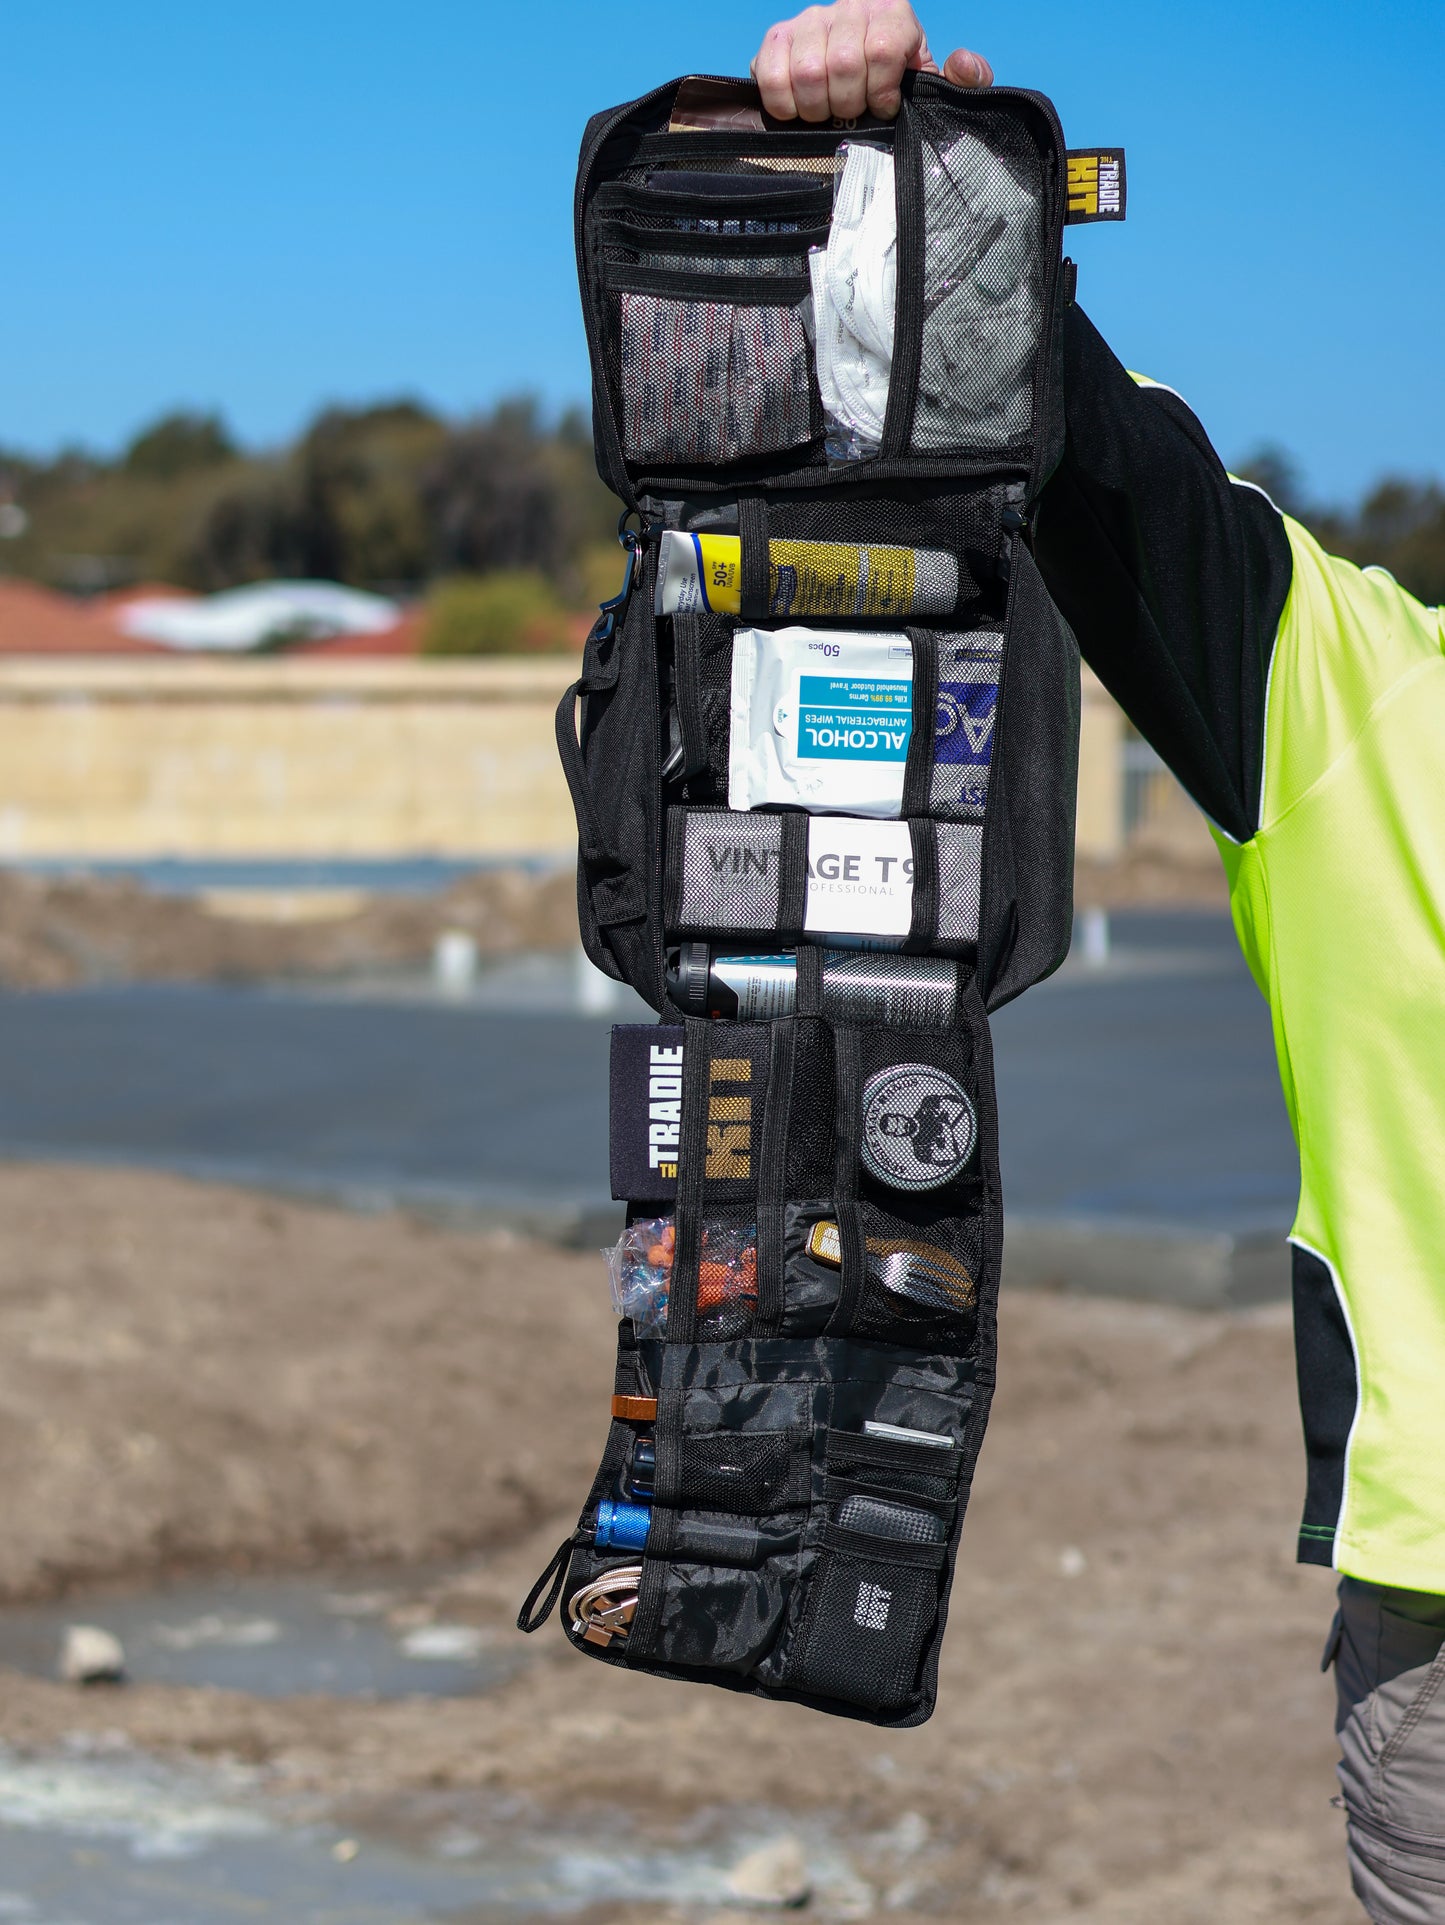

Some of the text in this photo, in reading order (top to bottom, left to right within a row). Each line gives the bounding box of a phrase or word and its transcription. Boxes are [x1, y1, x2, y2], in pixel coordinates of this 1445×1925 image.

[1067, 156, 1098, 215] KIT
[1099, 156, 1120, 214] THE TRADIE
[713, 562, 727, 587] 50+
[808, 642, 841, 657] 50pcs
[830, 681, 908, 693] Household Outdoor Travel
[849, 693, 869, 702] Germs
[894, 694, 908, 703] Kills
[805, 713, 907, 727] ANTIBACTERIAL WIPES
[805, 728, 907, 750] ALCOHOL
[809, 883, 895, 896] OFESSIONAL
[649, 1045, 684, 1178] TH TRADIE
